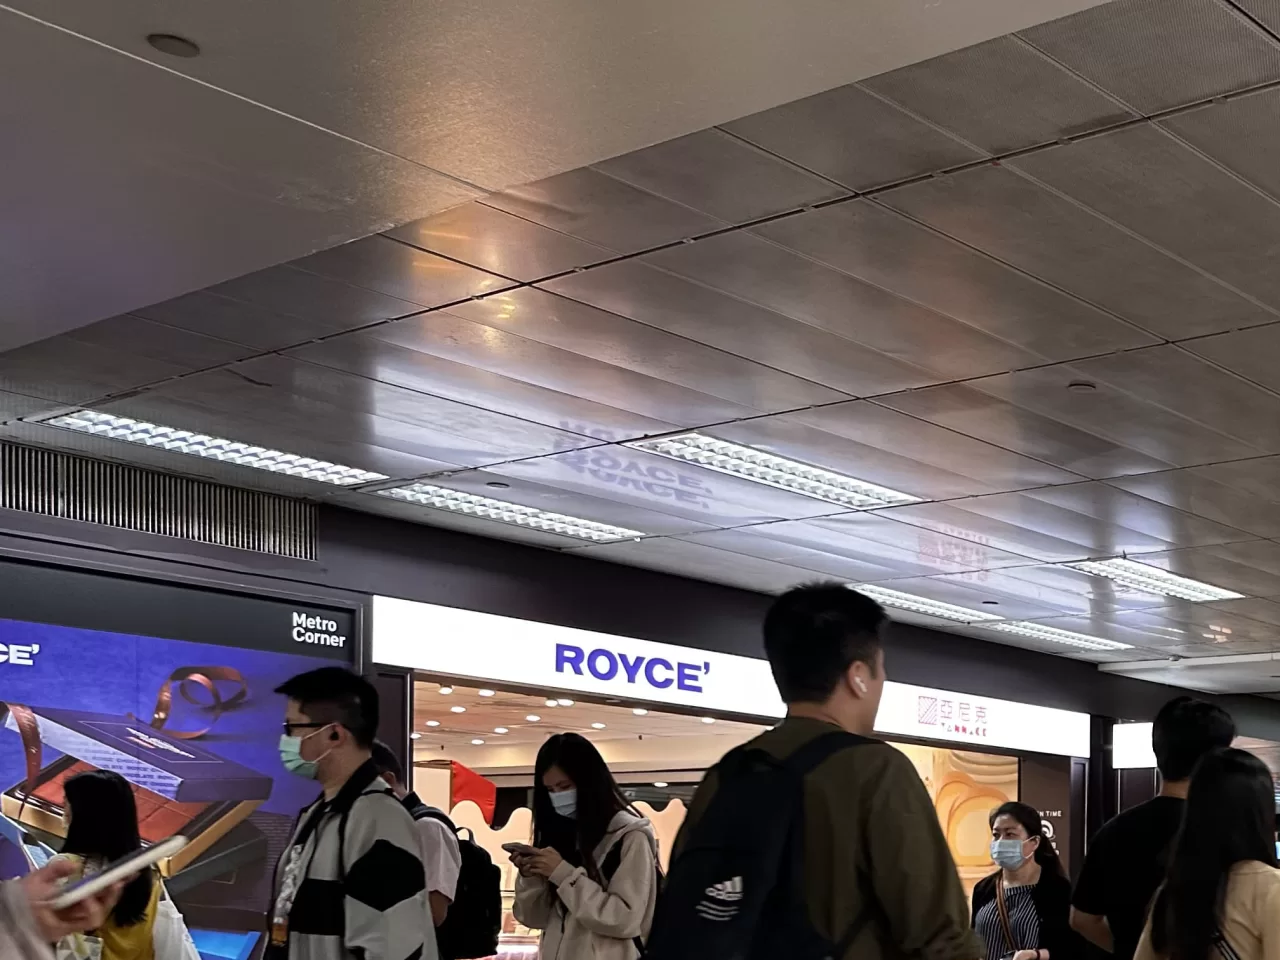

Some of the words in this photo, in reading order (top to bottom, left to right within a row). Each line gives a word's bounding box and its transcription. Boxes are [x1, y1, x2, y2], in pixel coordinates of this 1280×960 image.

[292, 612, 337, 632] Metro
[292, 627, 346, 648] Corner
[555, 643, 710, 693] ROYCE'
[940, 699, 987, 724] 亞尼克
